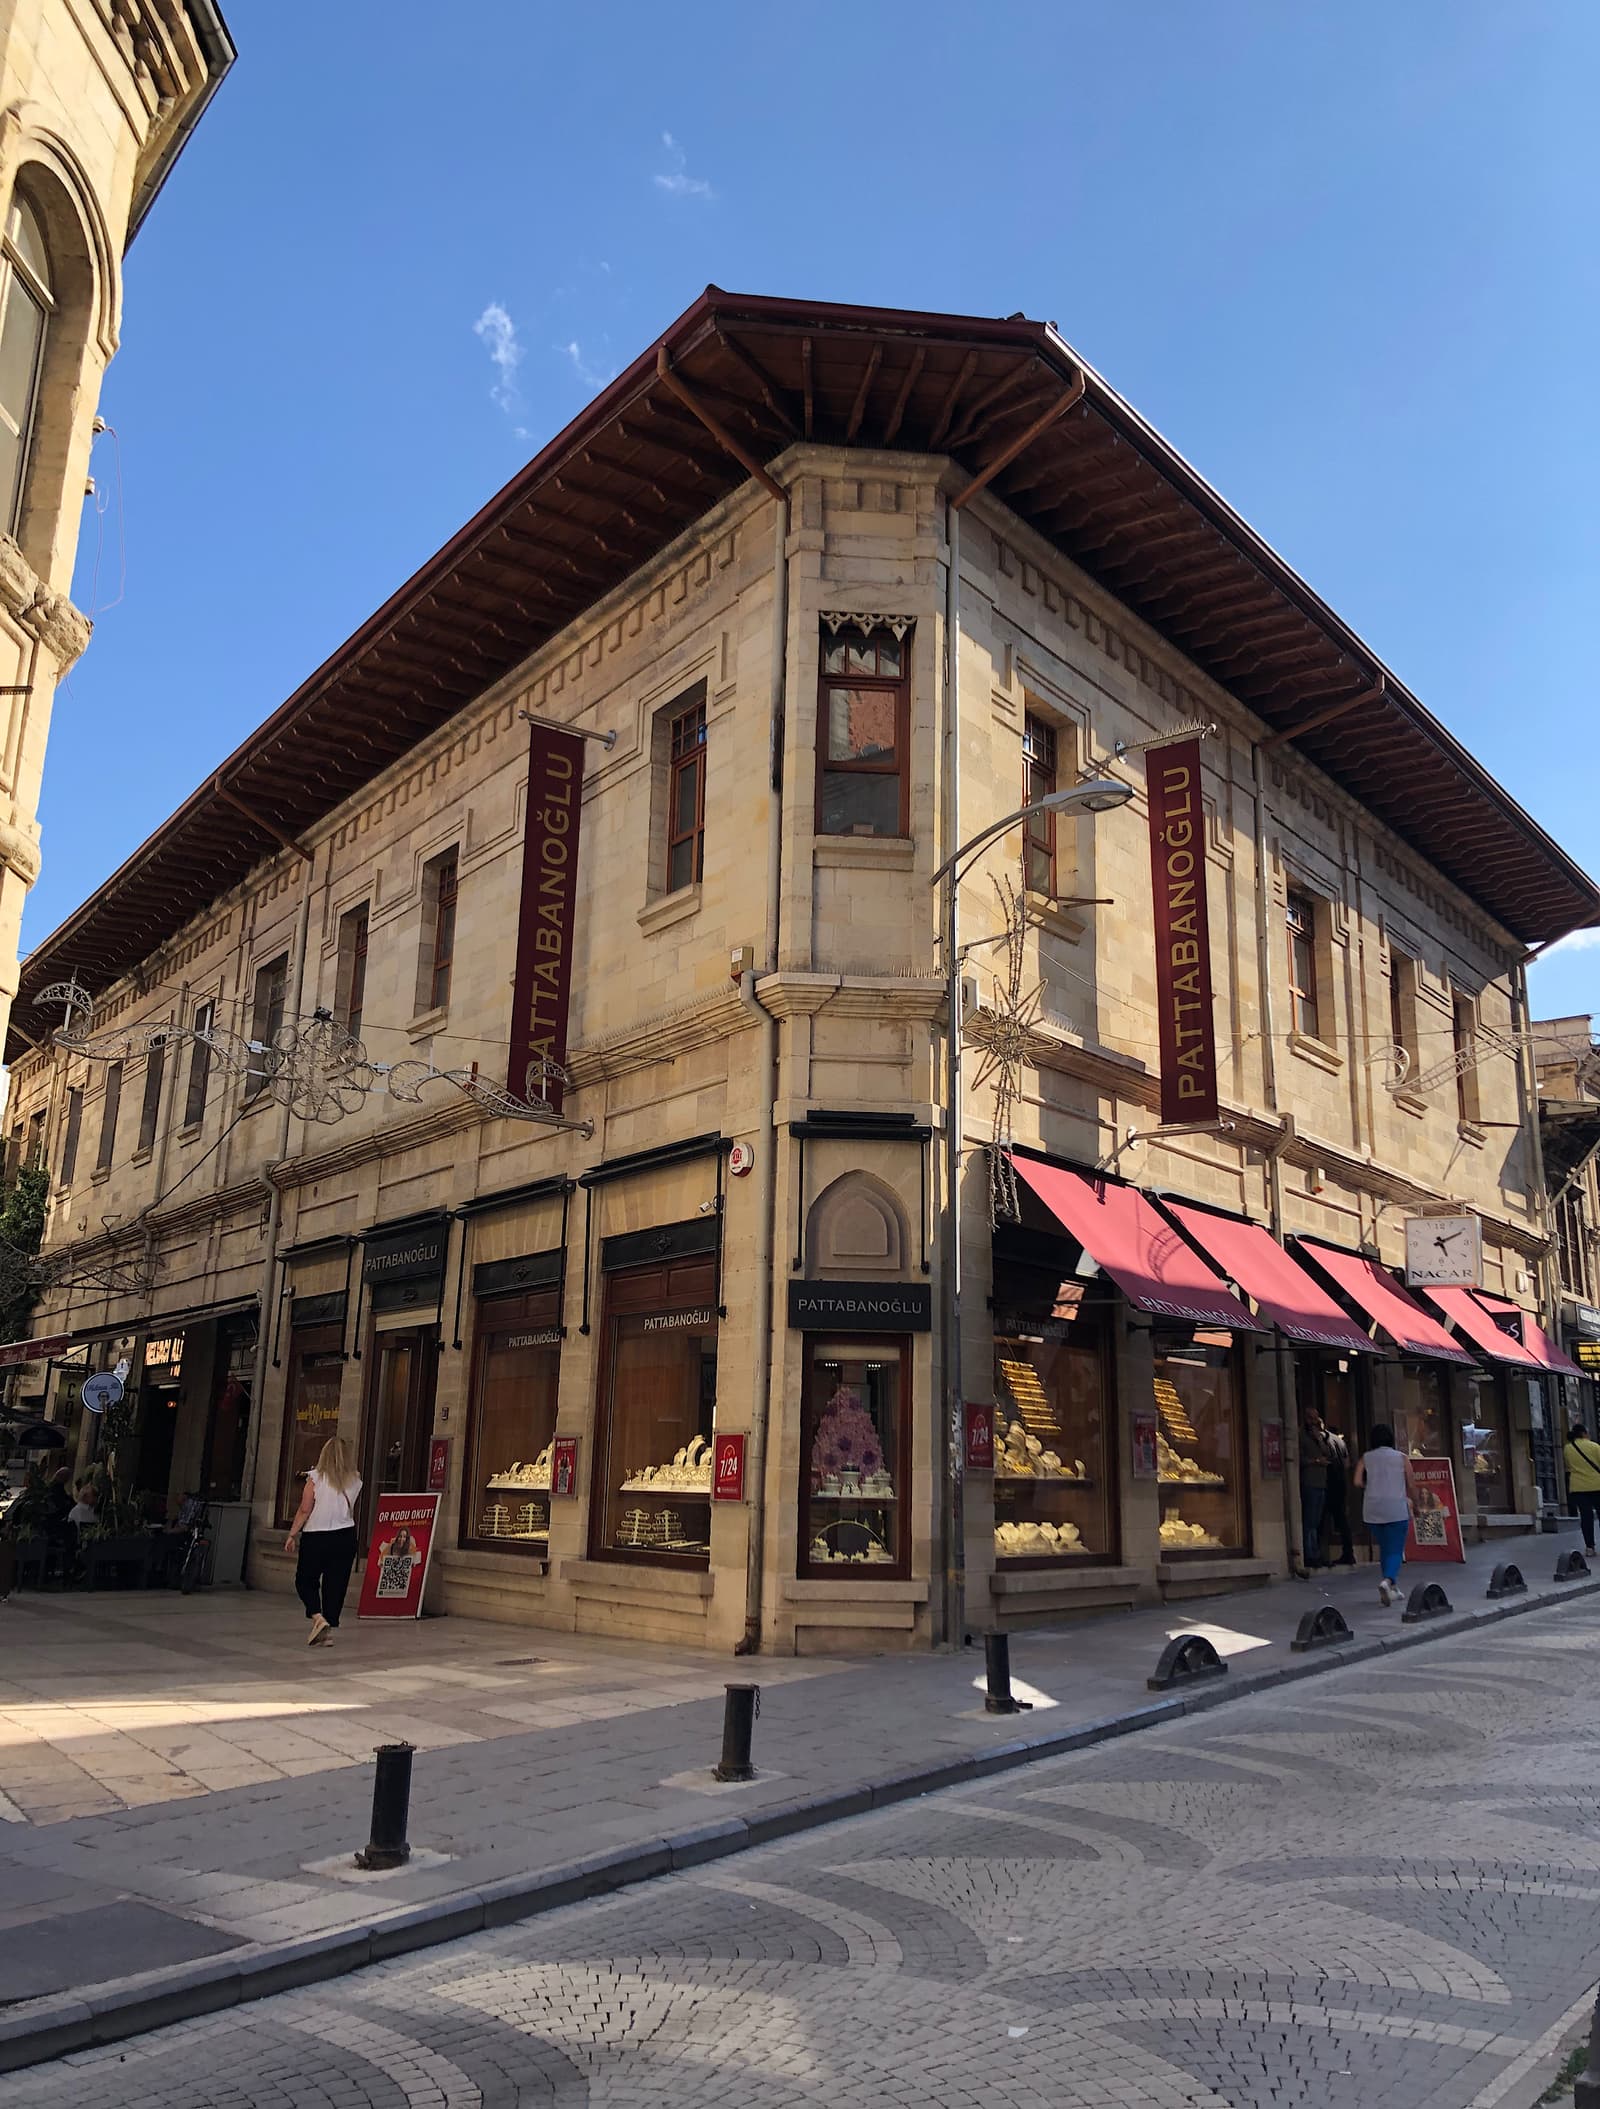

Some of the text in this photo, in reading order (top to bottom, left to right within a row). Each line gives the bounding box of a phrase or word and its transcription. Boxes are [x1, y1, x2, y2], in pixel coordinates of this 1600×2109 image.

[527, 752, 573, 1087] PATTABANOĞLU
[1159, 766, 1206, 1099] PATTABANOĞLU
[1434, 1222, 1446, 1230] 12
[364, 1243, 438, 1272] PATTABANOĞLU
[1411, 1269, 1473, 1279] NACAR
[797, 1298, 922, 1315] PATTABANOĞLU
[644, 1310, 710, 1330] PATTABANOĞLU
[972, 1427, 989, 1446] 7/24
[720, 1456, 738, 1478] 7/24
[390, 1509, 410, 1521] KODU
[411, 1508, 434, 1519] OKUT!
